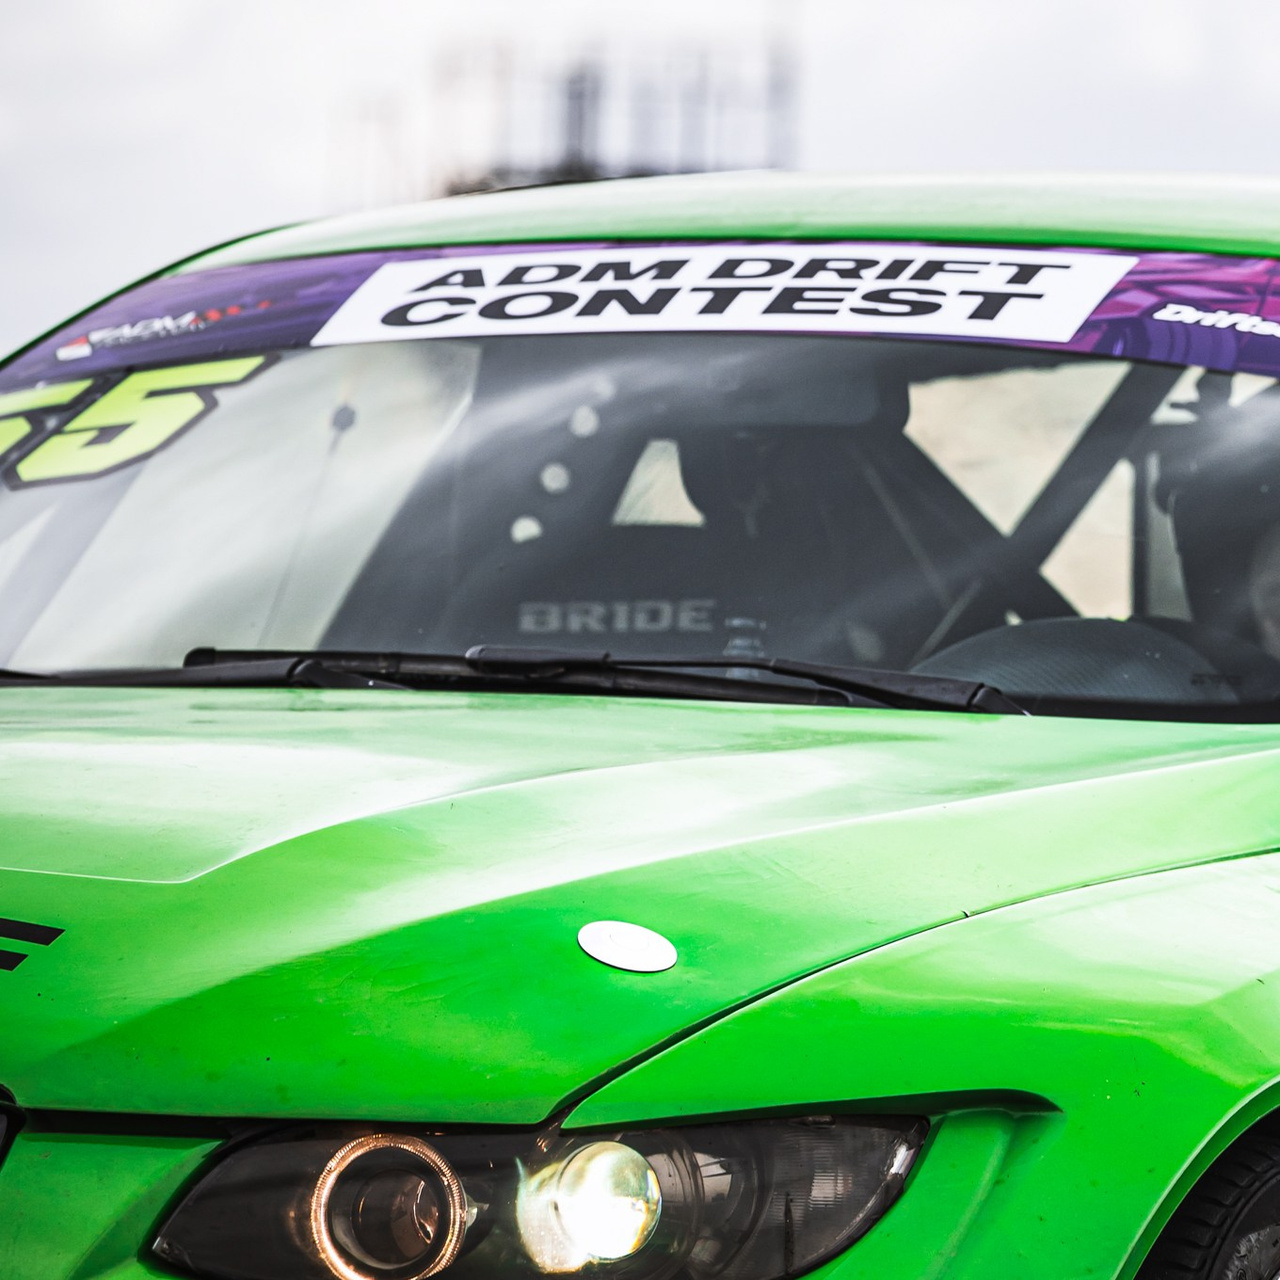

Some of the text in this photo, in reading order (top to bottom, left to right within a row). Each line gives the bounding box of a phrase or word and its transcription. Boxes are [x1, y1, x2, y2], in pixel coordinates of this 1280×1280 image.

[409, 257, 1071, 292] ADM DRIFT
[379, 286, 1044, 328] CONTEST
[518, 599, 716, 633] BRIDE
